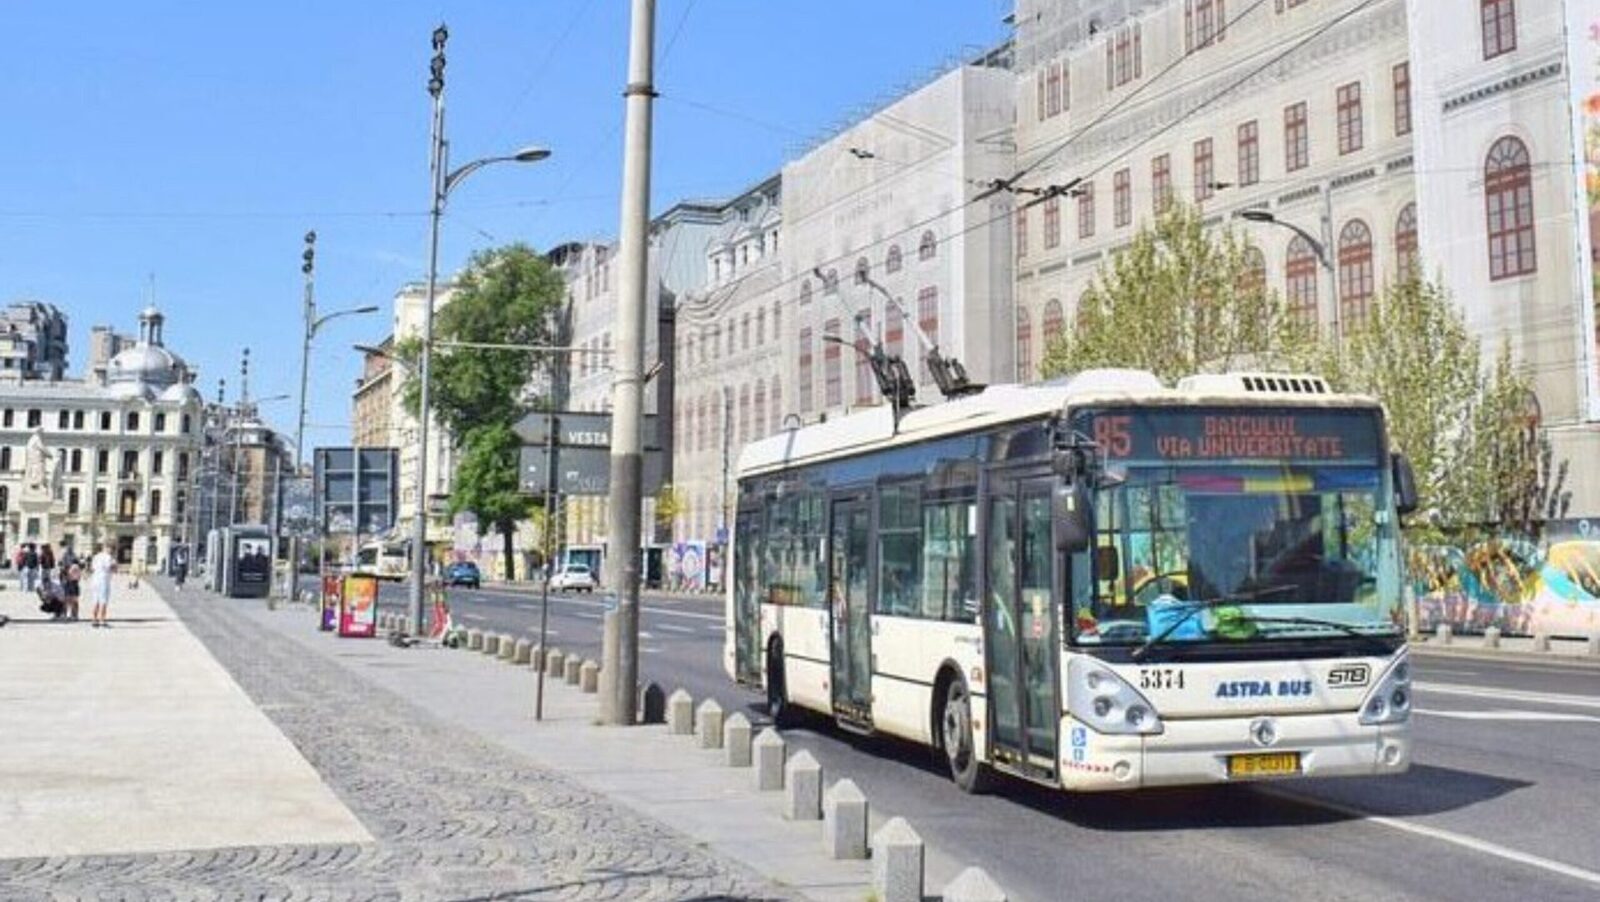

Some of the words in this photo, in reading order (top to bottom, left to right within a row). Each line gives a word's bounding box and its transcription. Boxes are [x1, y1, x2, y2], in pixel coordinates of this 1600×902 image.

[1204, 415, 1295, 436] BAICULUI
[568, 431, 609, 445] VESTA
[1156, 436, 1191, 457] VIA
[1198, 435, 1343, 457] UNIVERSITATE
[1140, 668, 1186, 690] 5374
[1327, 666, 1368, 687] STB
[1216, 680, 1273, 698] ASTRA
[1277, 680, 1313, 697] BUS
